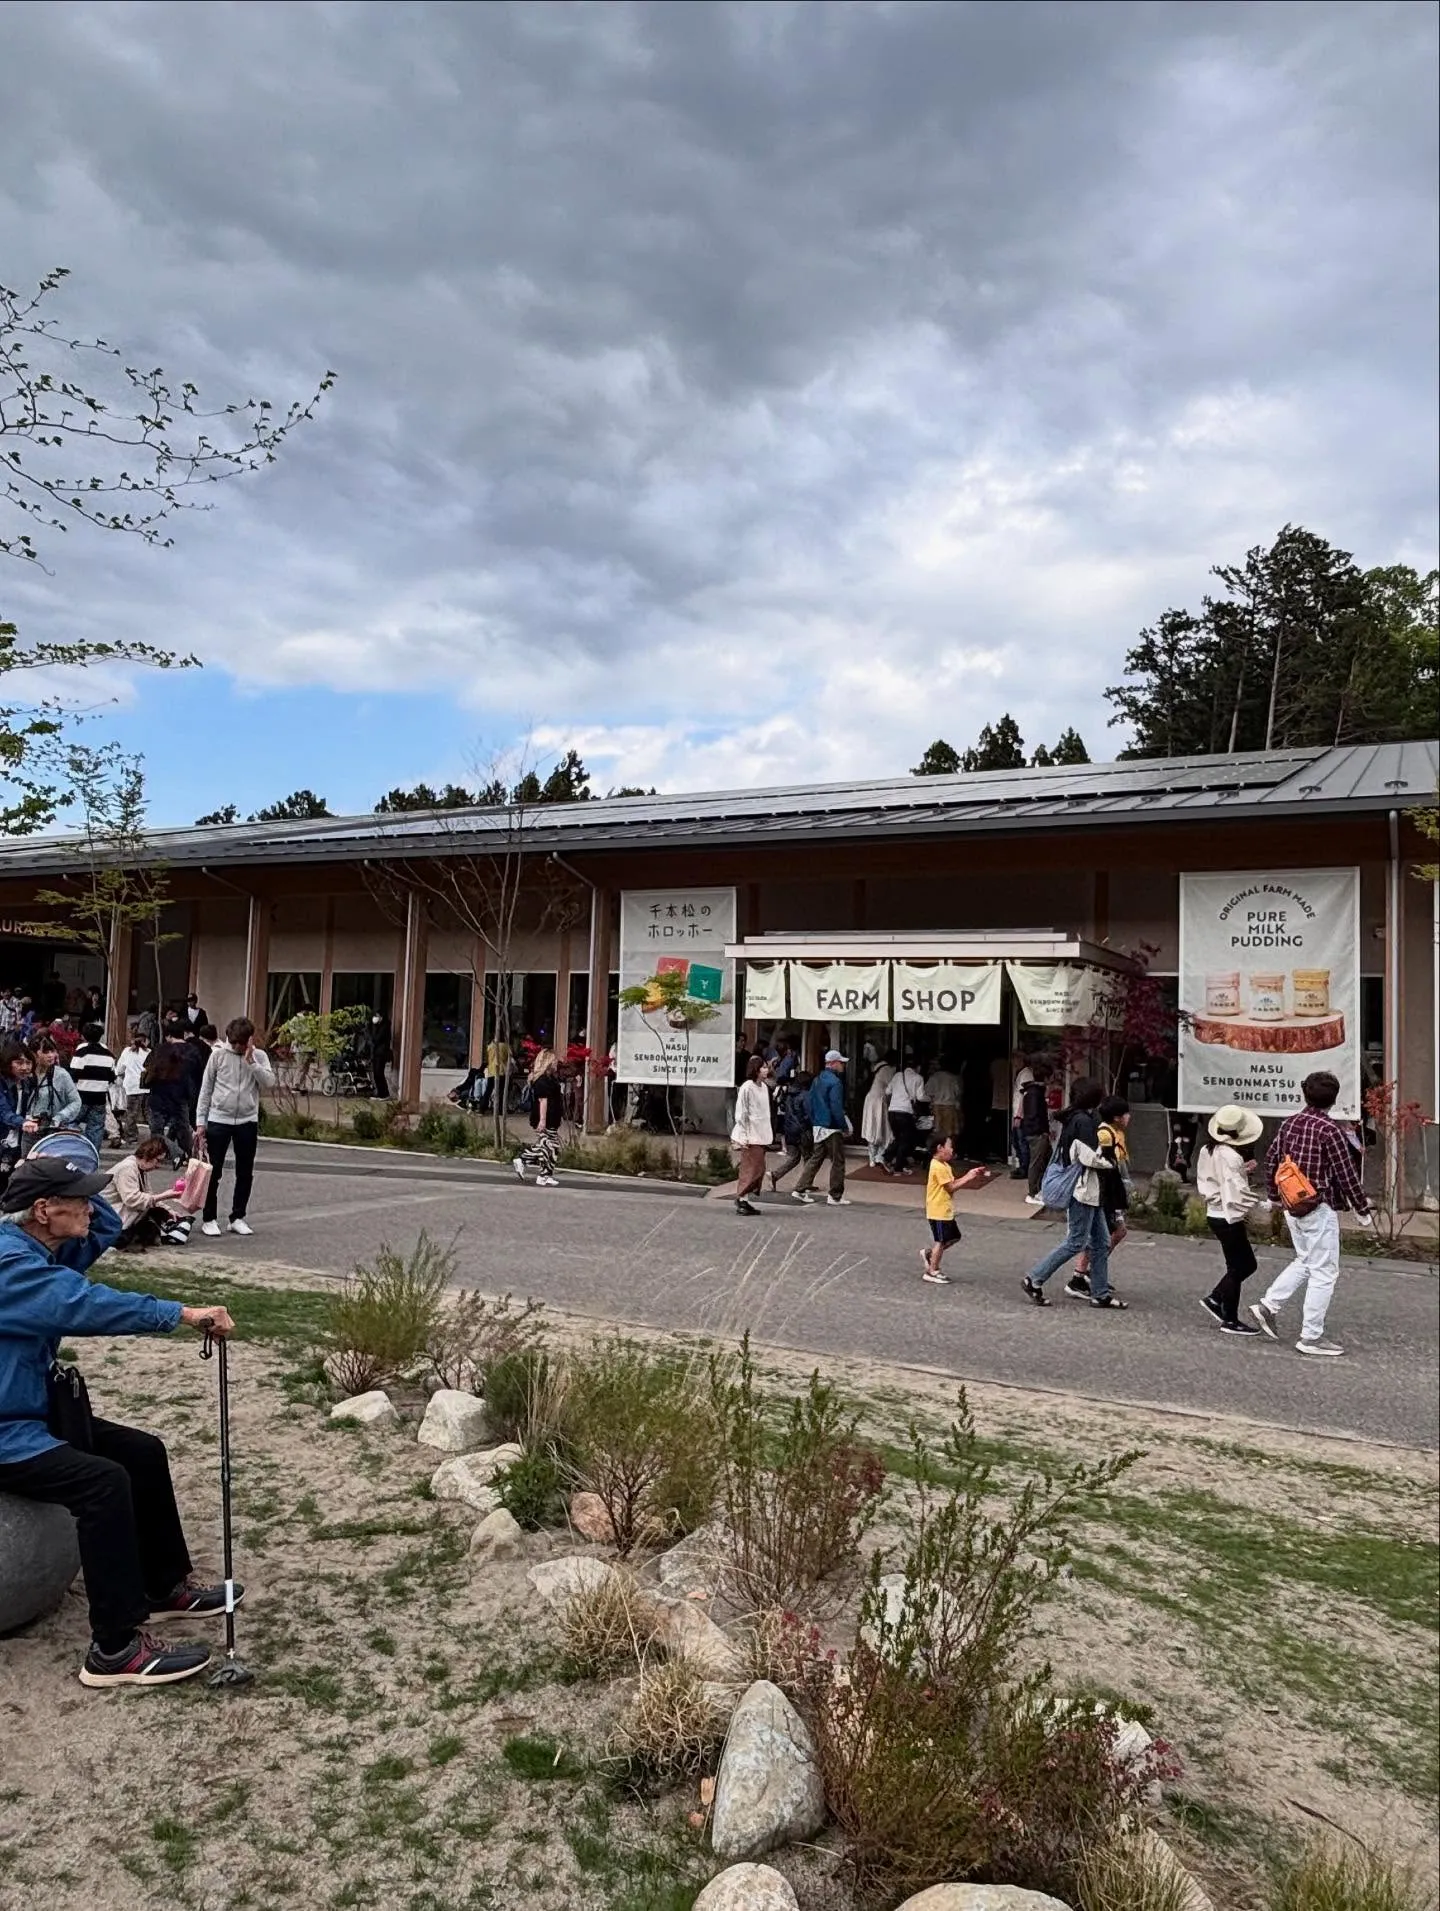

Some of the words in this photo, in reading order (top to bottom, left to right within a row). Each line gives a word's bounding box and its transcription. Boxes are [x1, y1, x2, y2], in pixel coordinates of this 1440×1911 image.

[1219, 885, 1260, 921] ORIGINAL
[1263, 884, 1292, 897] FARM
[1292, 893, 1316, 919] MADE
[649, 903, 712, 919] 千本松の
[1247, 911, 1287, 922] PURE
[1248, 923, 1285, 934] MILK
[1231, 935, 1303, 947] PUDDING
[816, 989, 880, 1010] FARM
[901, 989, 976, 1012] SHOP
[665, 1043, 687, 1051] NASU
[695, 1055, 719, 1063] FARM
[653, 1065, 677, 1073] SINCE
[1250, 1065, 1284, 1074] NASU
[1202, 1076, 1295, 1089] SENBONMATSU
[1233, 1091, 1269, 1102] SINCE
[1275, 1093, 1301, 1103] 1893
